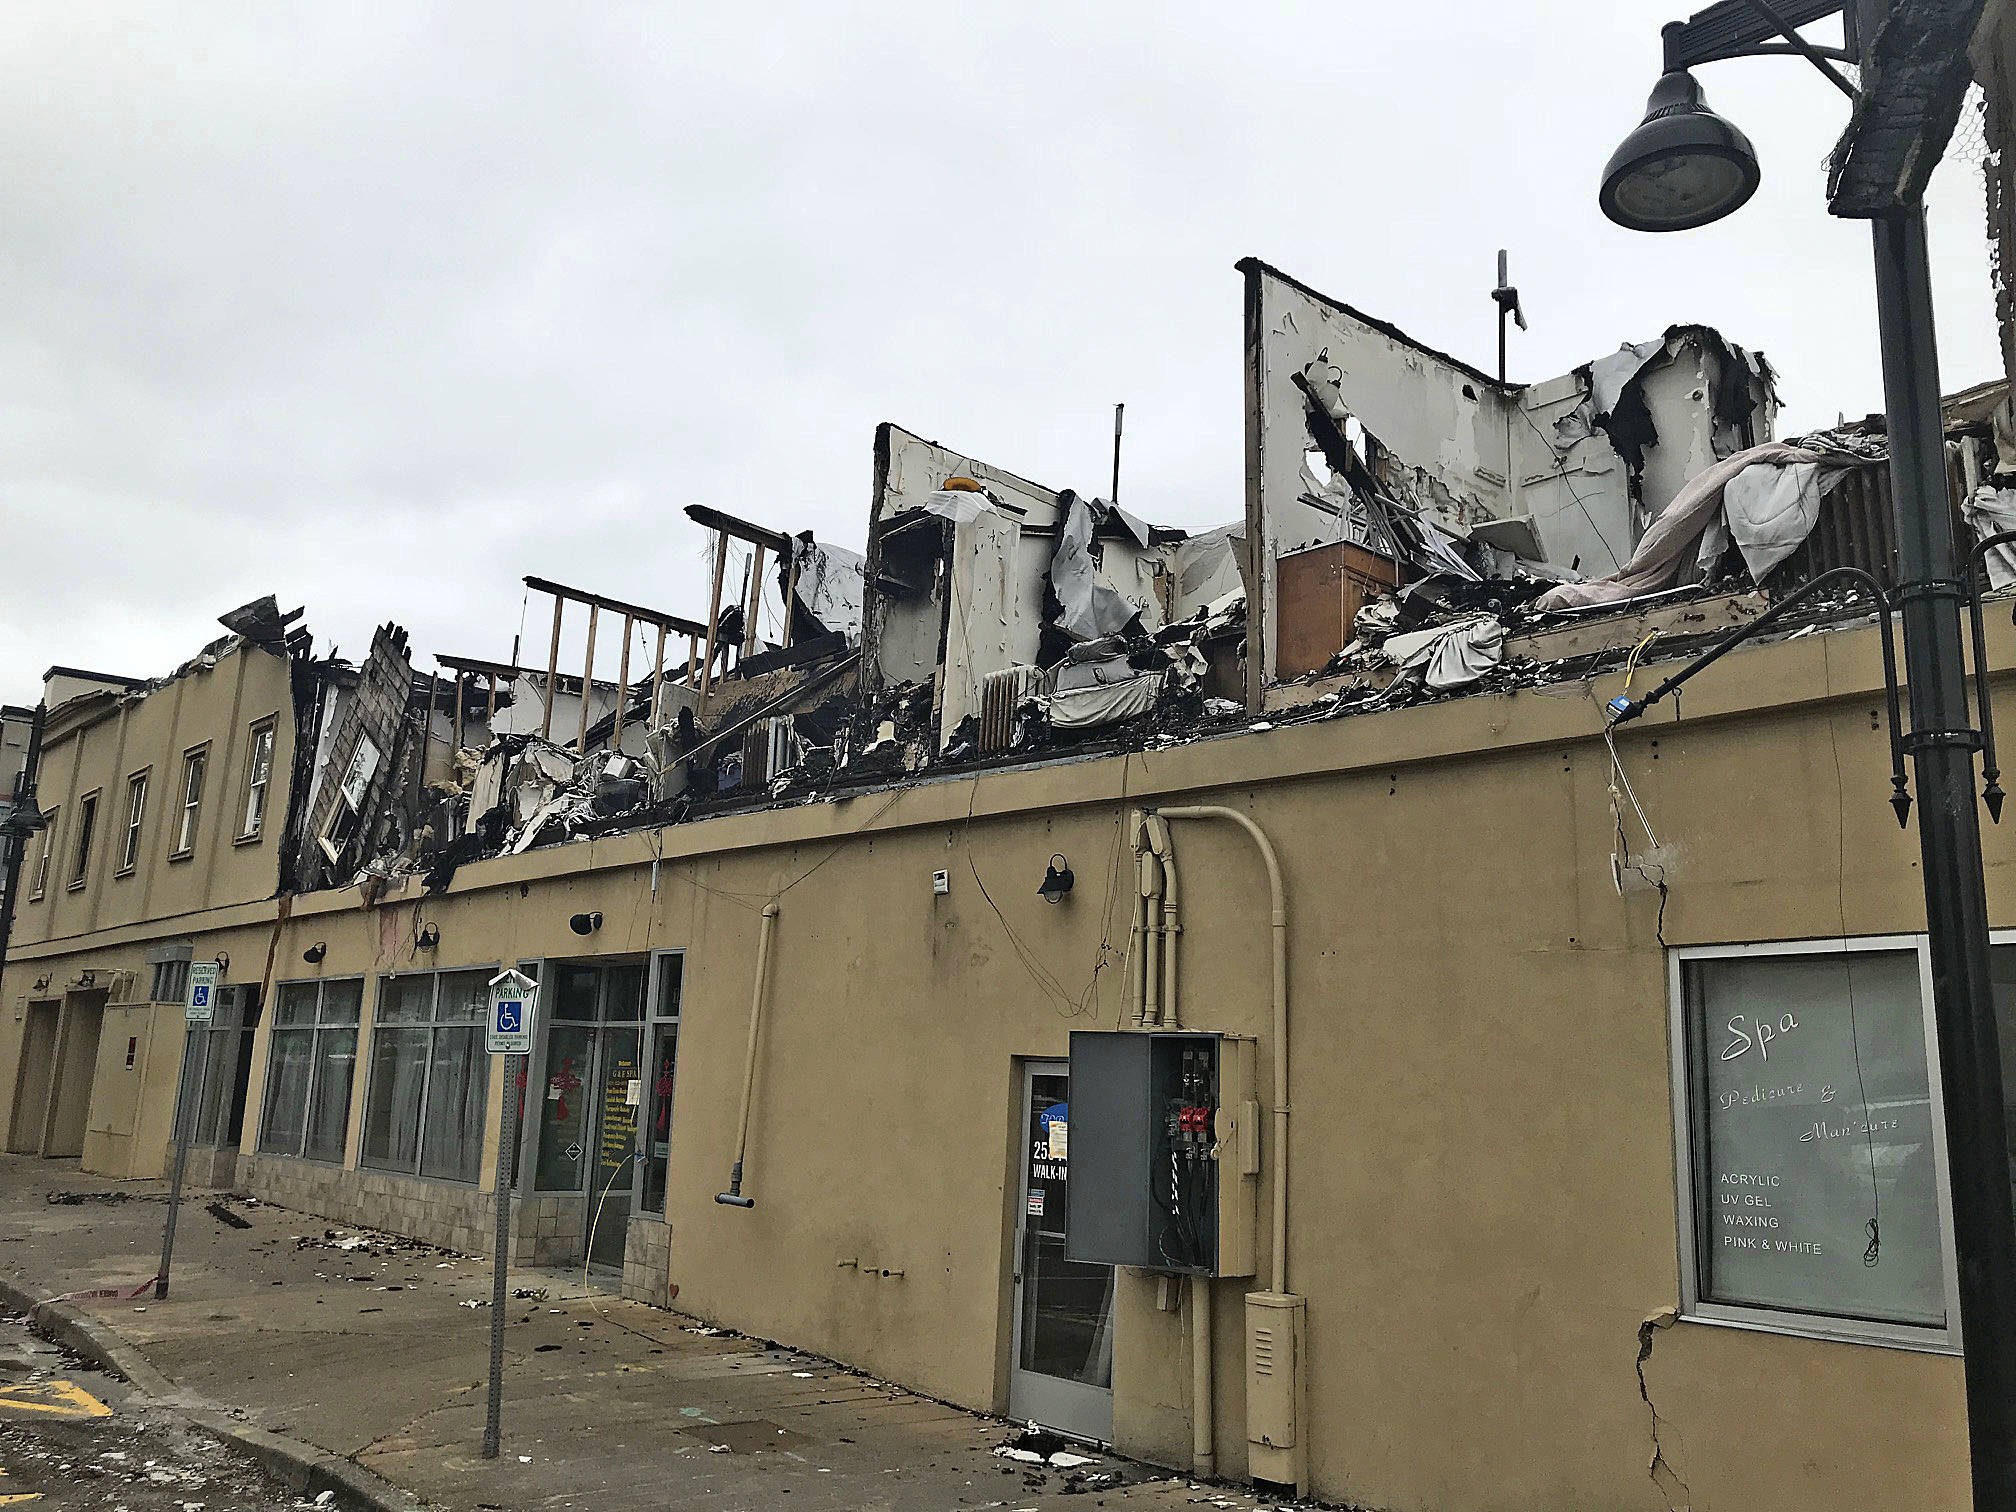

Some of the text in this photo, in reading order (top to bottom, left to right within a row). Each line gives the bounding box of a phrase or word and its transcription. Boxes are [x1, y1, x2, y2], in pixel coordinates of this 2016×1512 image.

[495, 987, 529, 998] PARKING
[1721, 1013, 1800, 1062] Spa
[1720, 1084, 1837, 1110] Pedicure &
[1721, 1173, 1780, 1187] ACRYLIC
[1721, 1194, 1772, 1207] UV GEL
[1723, 1214, 1779, 1228] WAXING
[1724, 1236, 1822, 1255] PINK & WHITE
